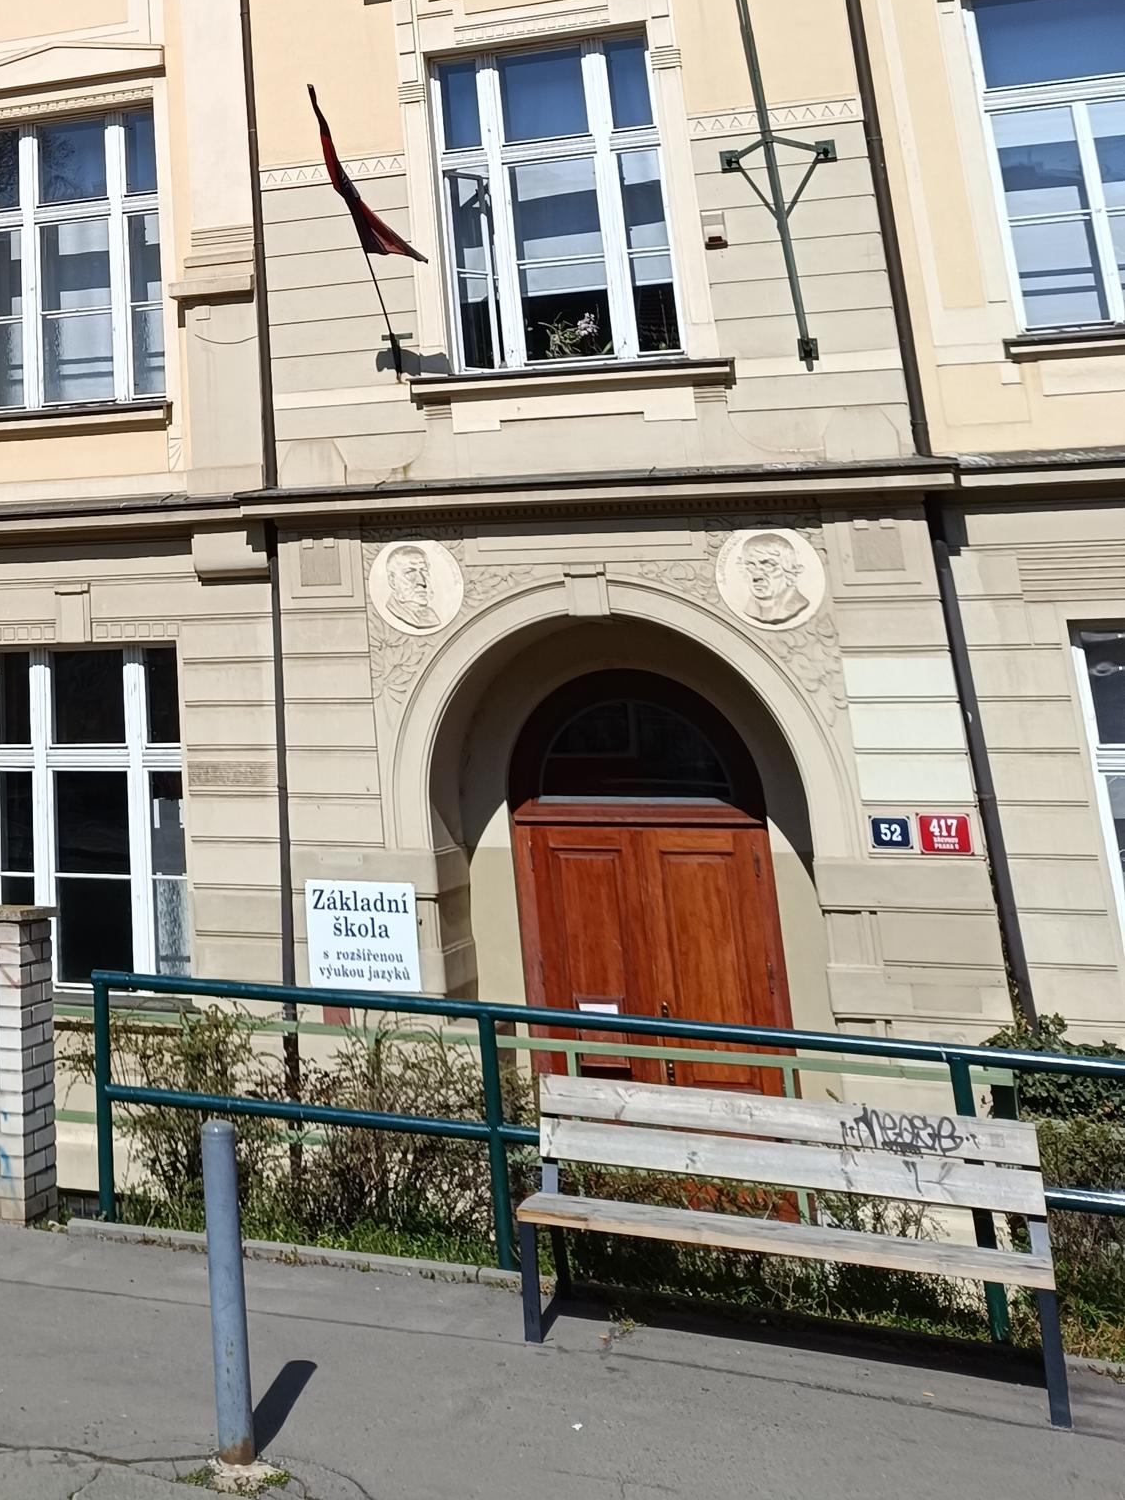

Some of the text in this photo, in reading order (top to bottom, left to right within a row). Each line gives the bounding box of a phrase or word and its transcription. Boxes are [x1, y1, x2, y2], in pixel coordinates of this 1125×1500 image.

[880, 823, 903, 842] 52
[929, 818, 958, 837] 417
[312, 888, 410, 914] Základní
[333, 915, 390, 939] škola
[323, 947, 404, 963] s rozšířenou
[319, 963, 365, 980] výukou
